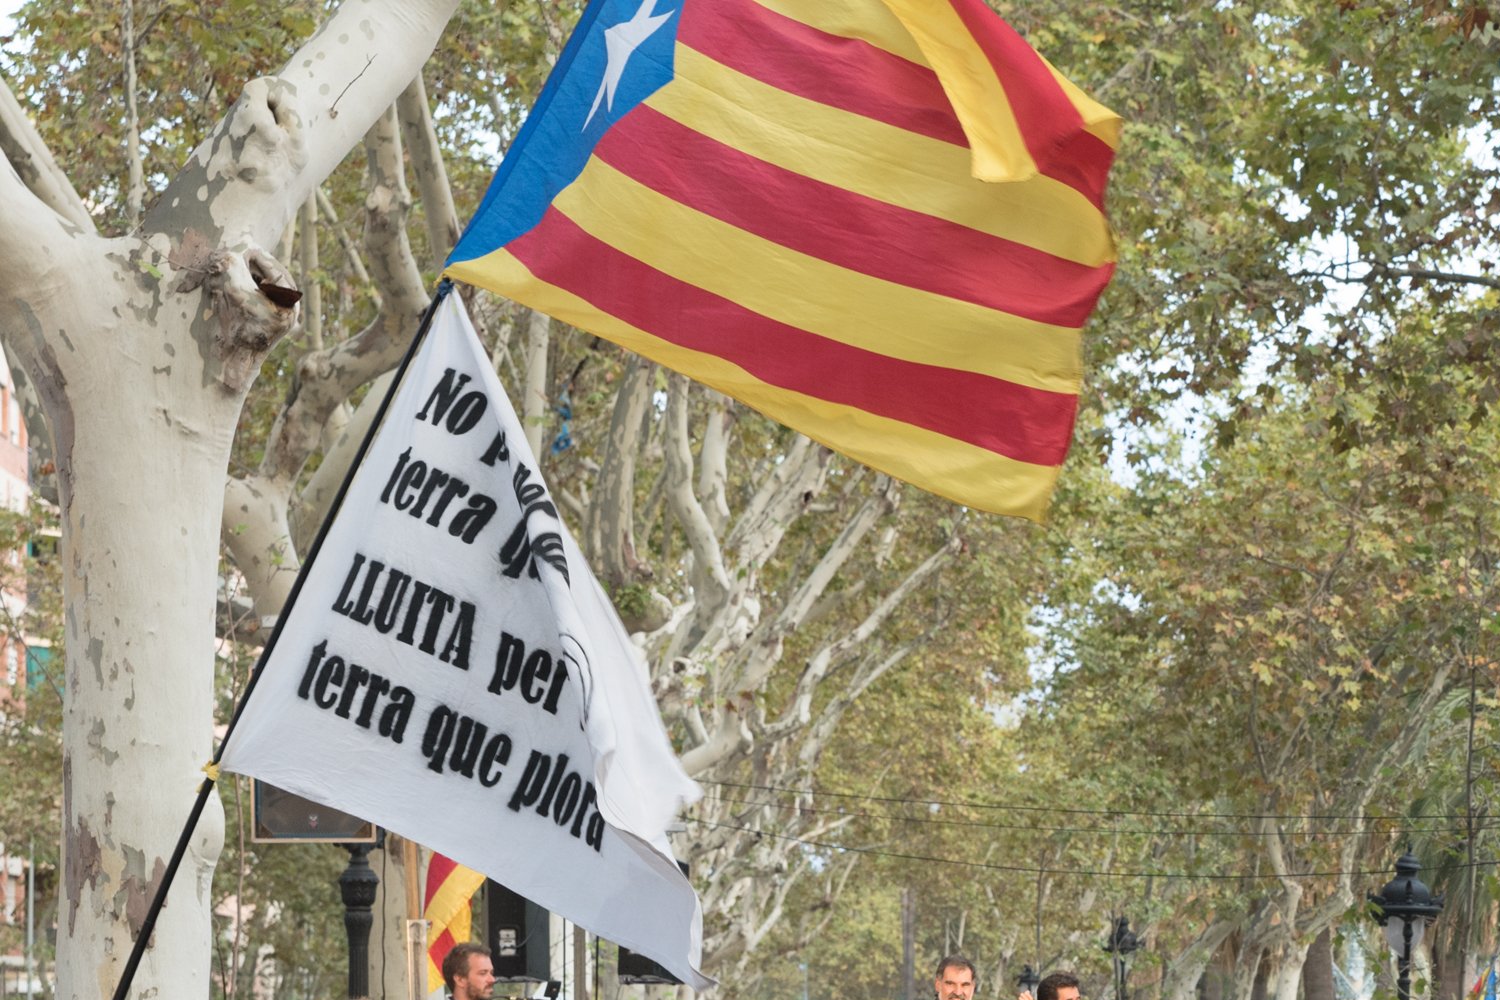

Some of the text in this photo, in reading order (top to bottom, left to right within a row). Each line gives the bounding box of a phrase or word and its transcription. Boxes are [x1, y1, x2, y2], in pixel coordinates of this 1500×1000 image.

[380, 446, 498, 545] terra
[331, 552, 477, 671] LLUITA
[297, 639, 416, 744] terra
[487, 631, 570, 716] per
[418, 704, 606, 853] que plora
